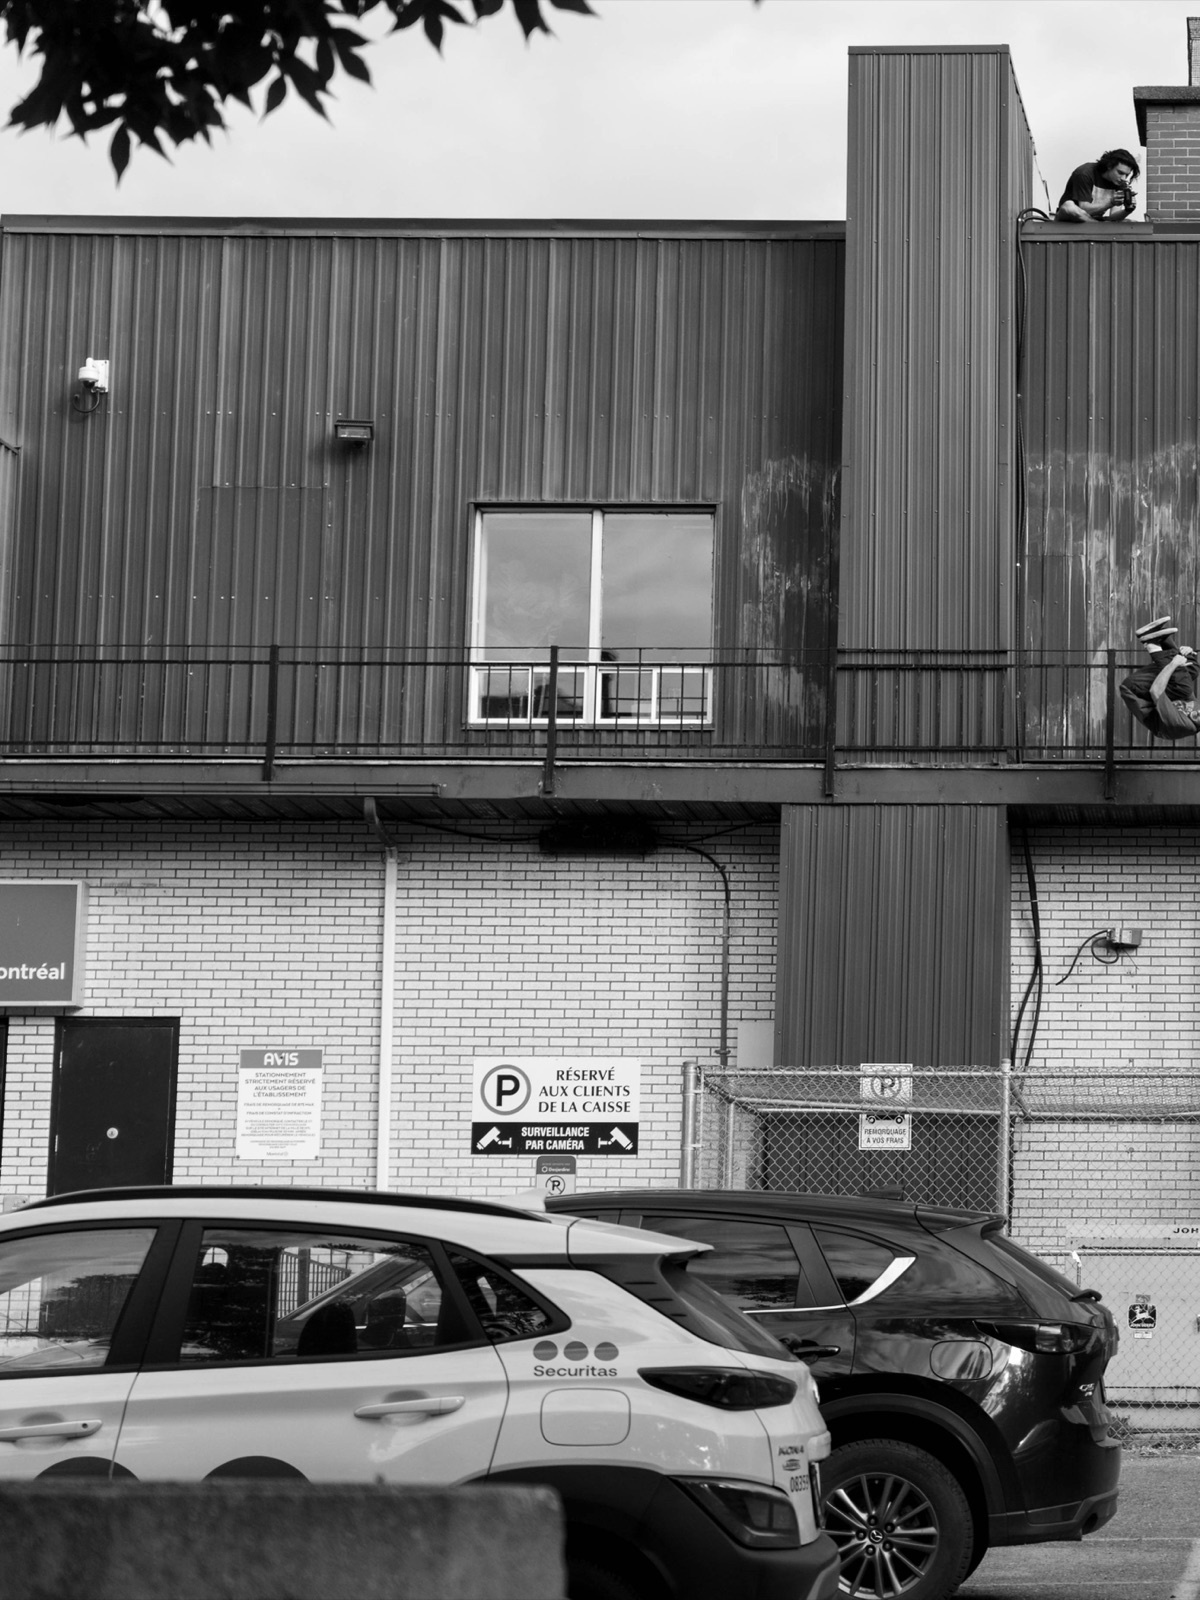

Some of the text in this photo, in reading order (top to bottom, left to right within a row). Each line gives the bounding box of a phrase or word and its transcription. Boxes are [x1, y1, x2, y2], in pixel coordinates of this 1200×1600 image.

[0, 962, 65, 980] ontréal
[264, 1052, 299, 1066] AVIS
[556, 1067, 615, 1081] RÉSERVÉ
[539, 1086, 630, 1097] AUX CLIENTS
[538, 1102, 631, 1112] DE LA CAISSE
[521, 1127, 590, 1137] SURVEILLANCE
[525, 1138, 584, 1150] PAR CAMÉRA
[534, 1365, 618, 1377] Securitas
